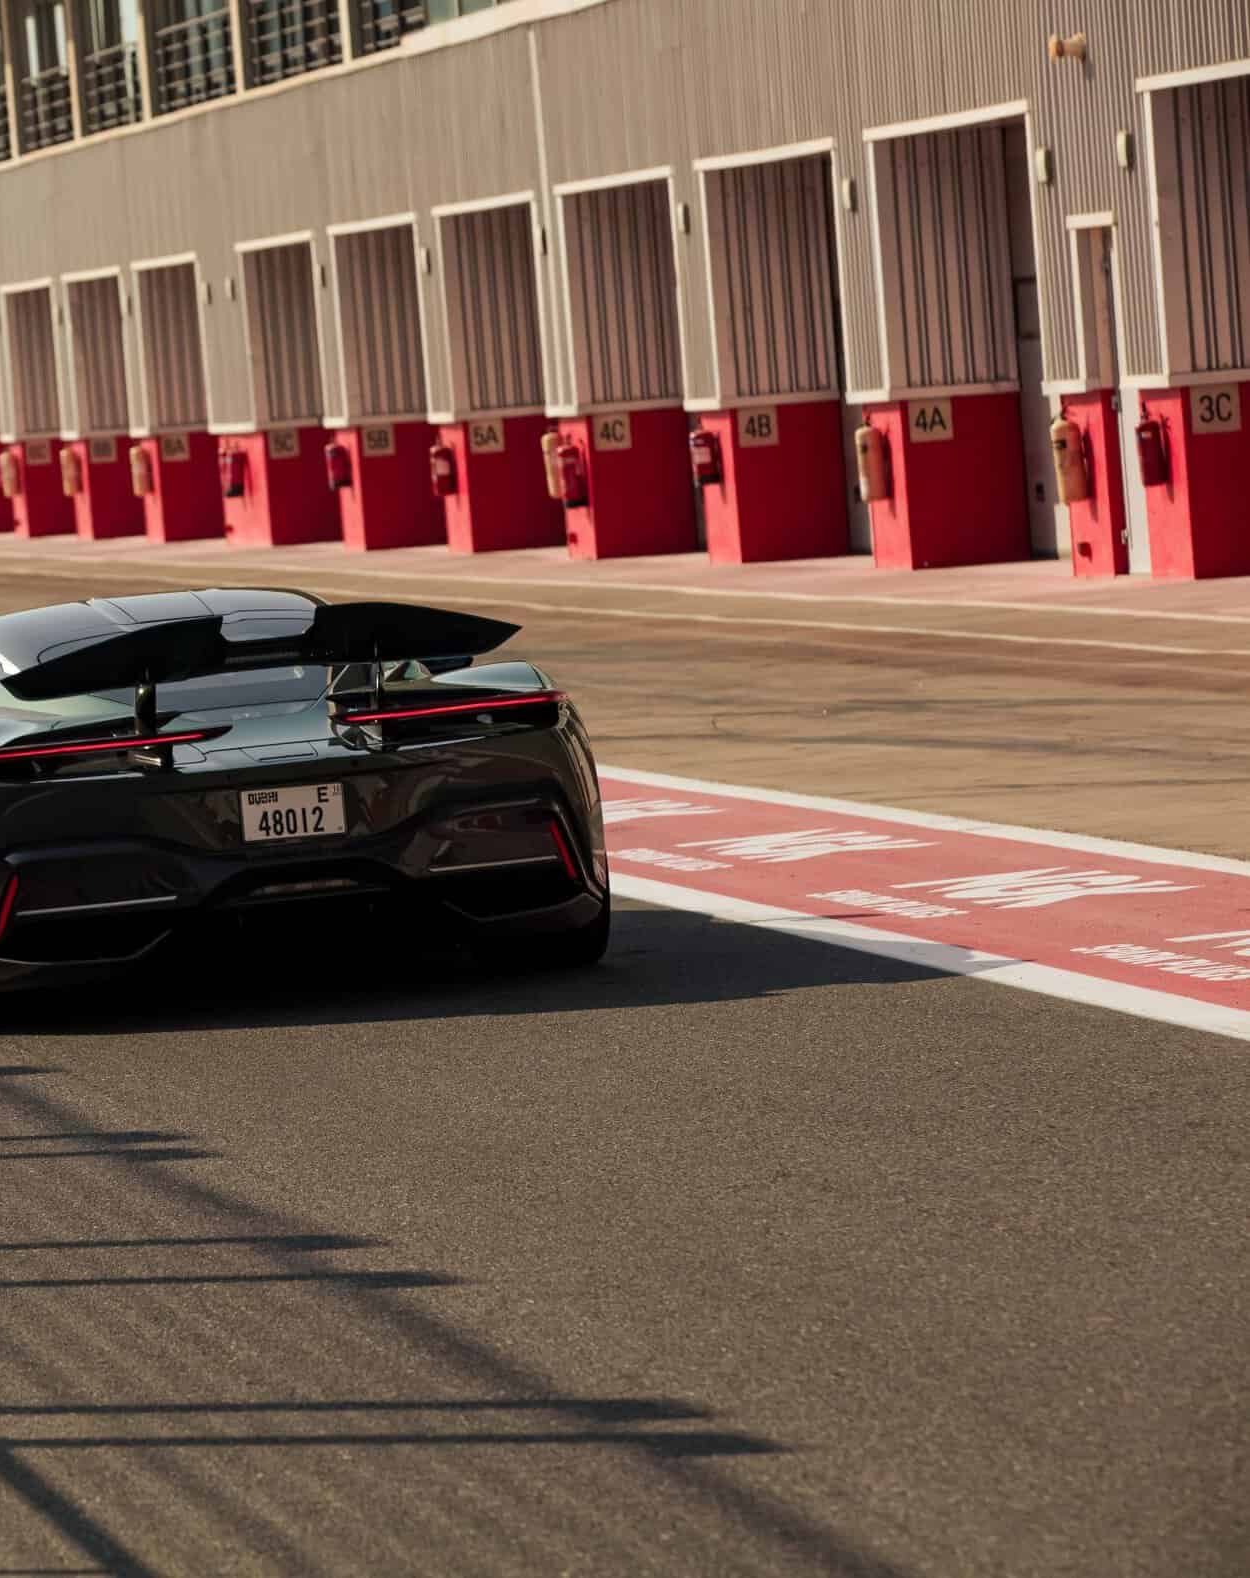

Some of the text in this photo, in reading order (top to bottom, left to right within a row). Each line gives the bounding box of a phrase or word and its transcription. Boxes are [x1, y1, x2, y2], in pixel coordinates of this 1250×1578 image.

[915, 406, 947, 432] 4A
[1199, 392, 1232, 422] 3C
[473, 425, 499, 447] 5A
[600, 419, 625, 442] 4C
[745, 414, 772, 437] 4B
[317, 786, 330, 803] E
[258, 806, 325, 837] 48012
[889, 866, 1206, 909] NGK
